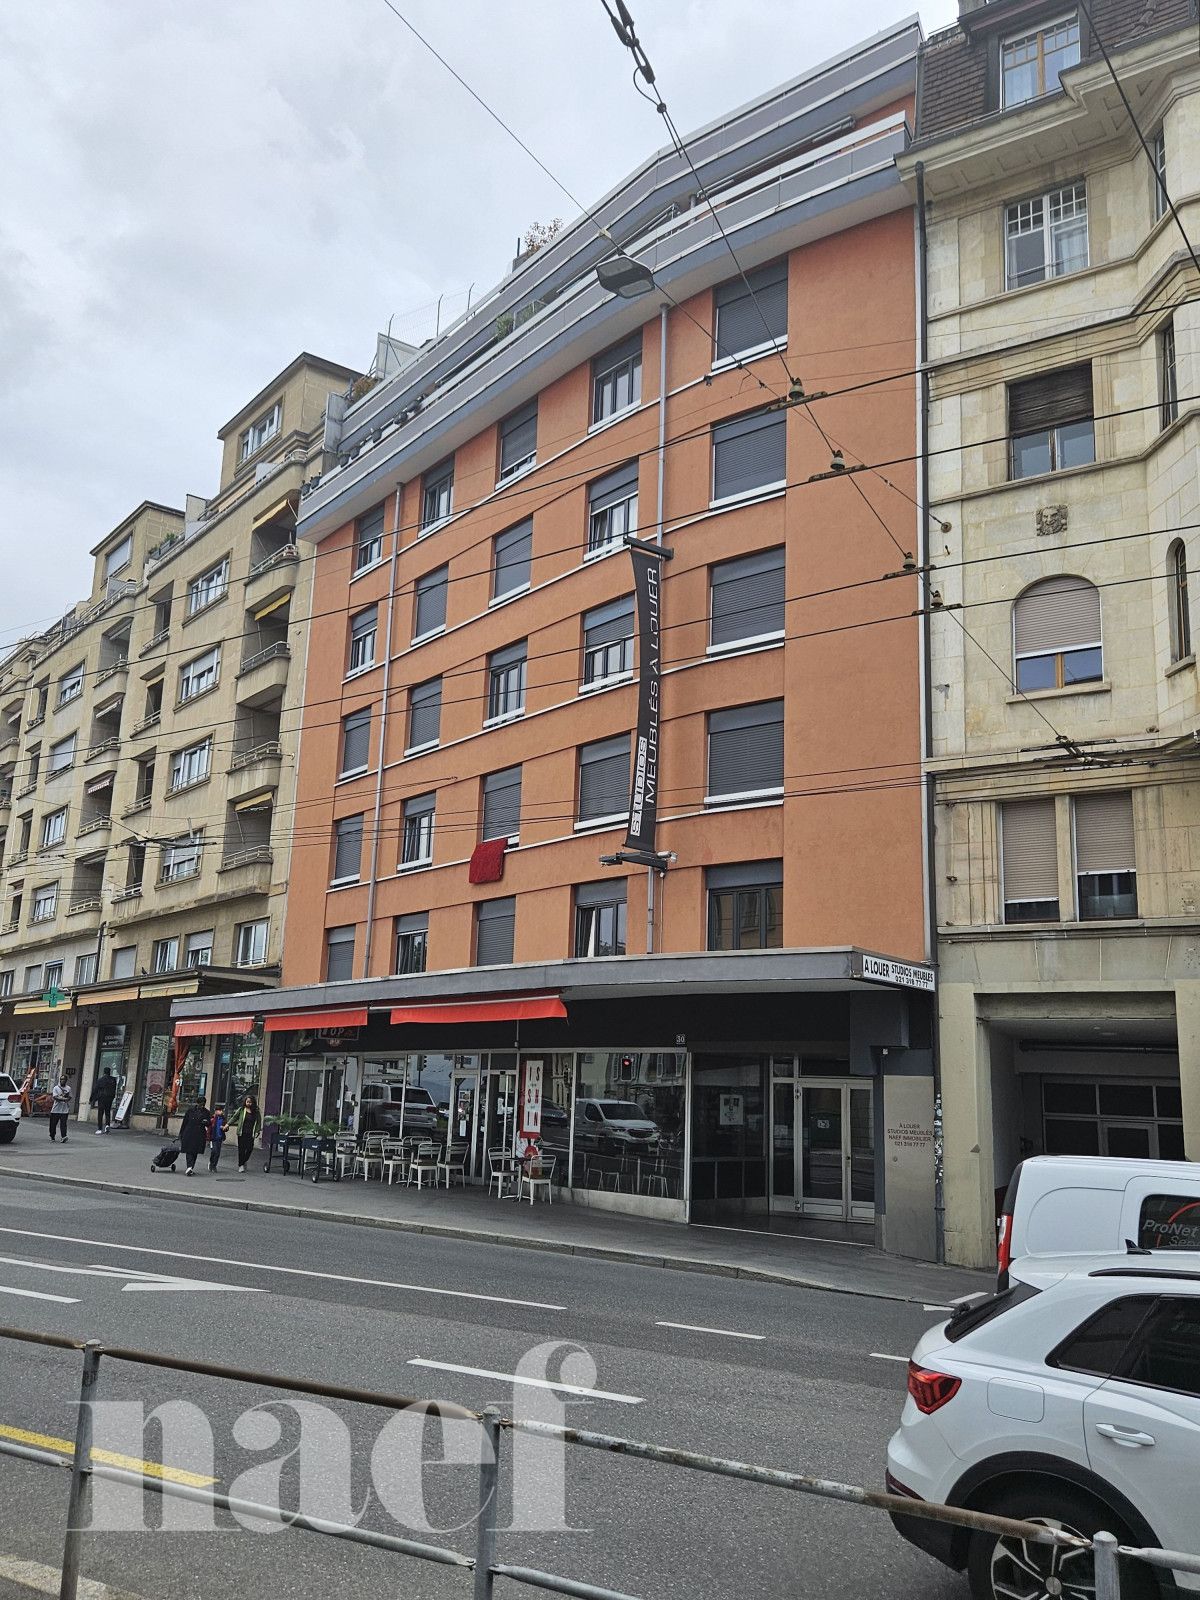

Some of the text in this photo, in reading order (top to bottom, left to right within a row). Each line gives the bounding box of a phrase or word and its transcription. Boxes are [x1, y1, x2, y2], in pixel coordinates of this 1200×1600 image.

[647, 567, 660, 650] LOUER
[645, 680, 659, 804] MEUBLÉS
[631, 739, 647, 836] STUDIOS
[865, 959, 869, 972] A
[870, 961, 890, 977] LOUER
[891, 964, 912, 977] STUDIOS
[676, 1034, 686, 1043] 30
[1142, 1219, 1199, 1237] ProNet
